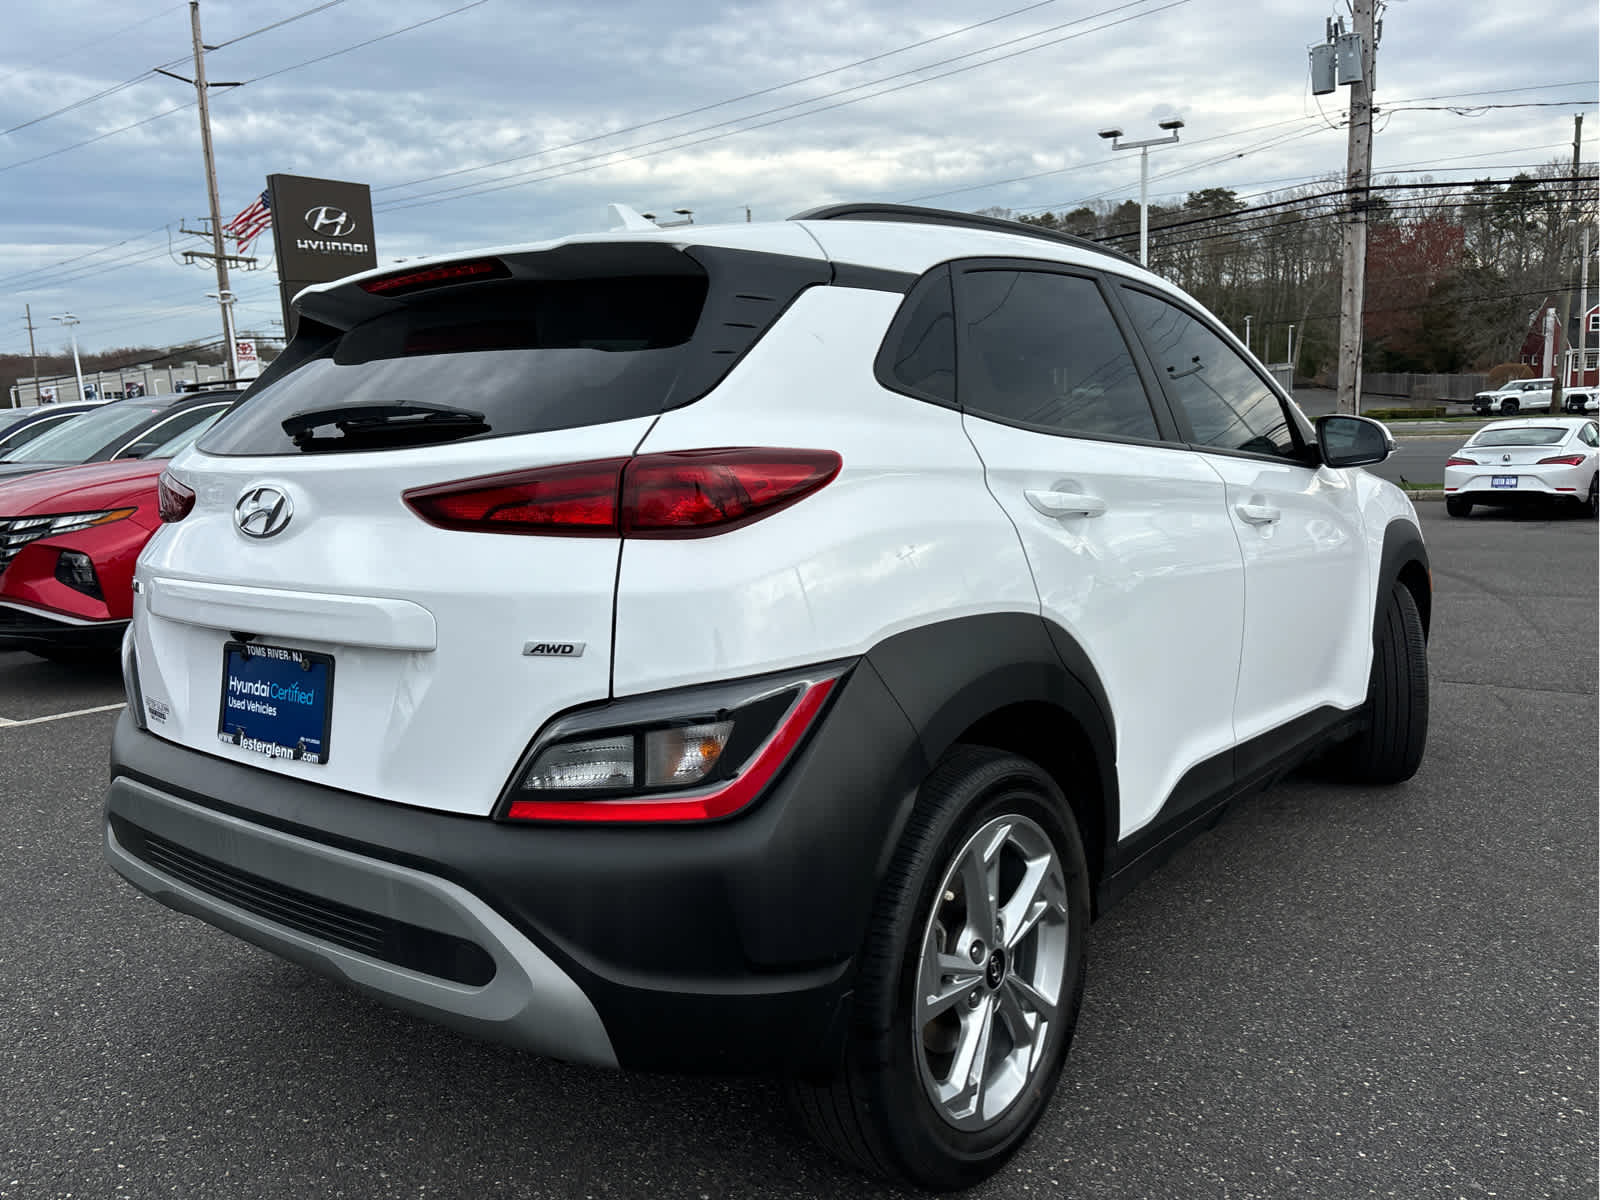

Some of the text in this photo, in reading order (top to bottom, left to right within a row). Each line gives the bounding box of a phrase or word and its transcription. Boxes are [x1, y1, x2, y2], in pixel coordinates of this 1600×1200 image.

[296, 239, 369, 254] HYUNDAI
[246, 645, 266, 658] TOMS
[292, 651, 303, 663] NJ
[530, 643, 575, 655] AWD
[229, 675, 315, 706] Hyundai Certified
[228, 695, 277, 717] Used Vehicles
